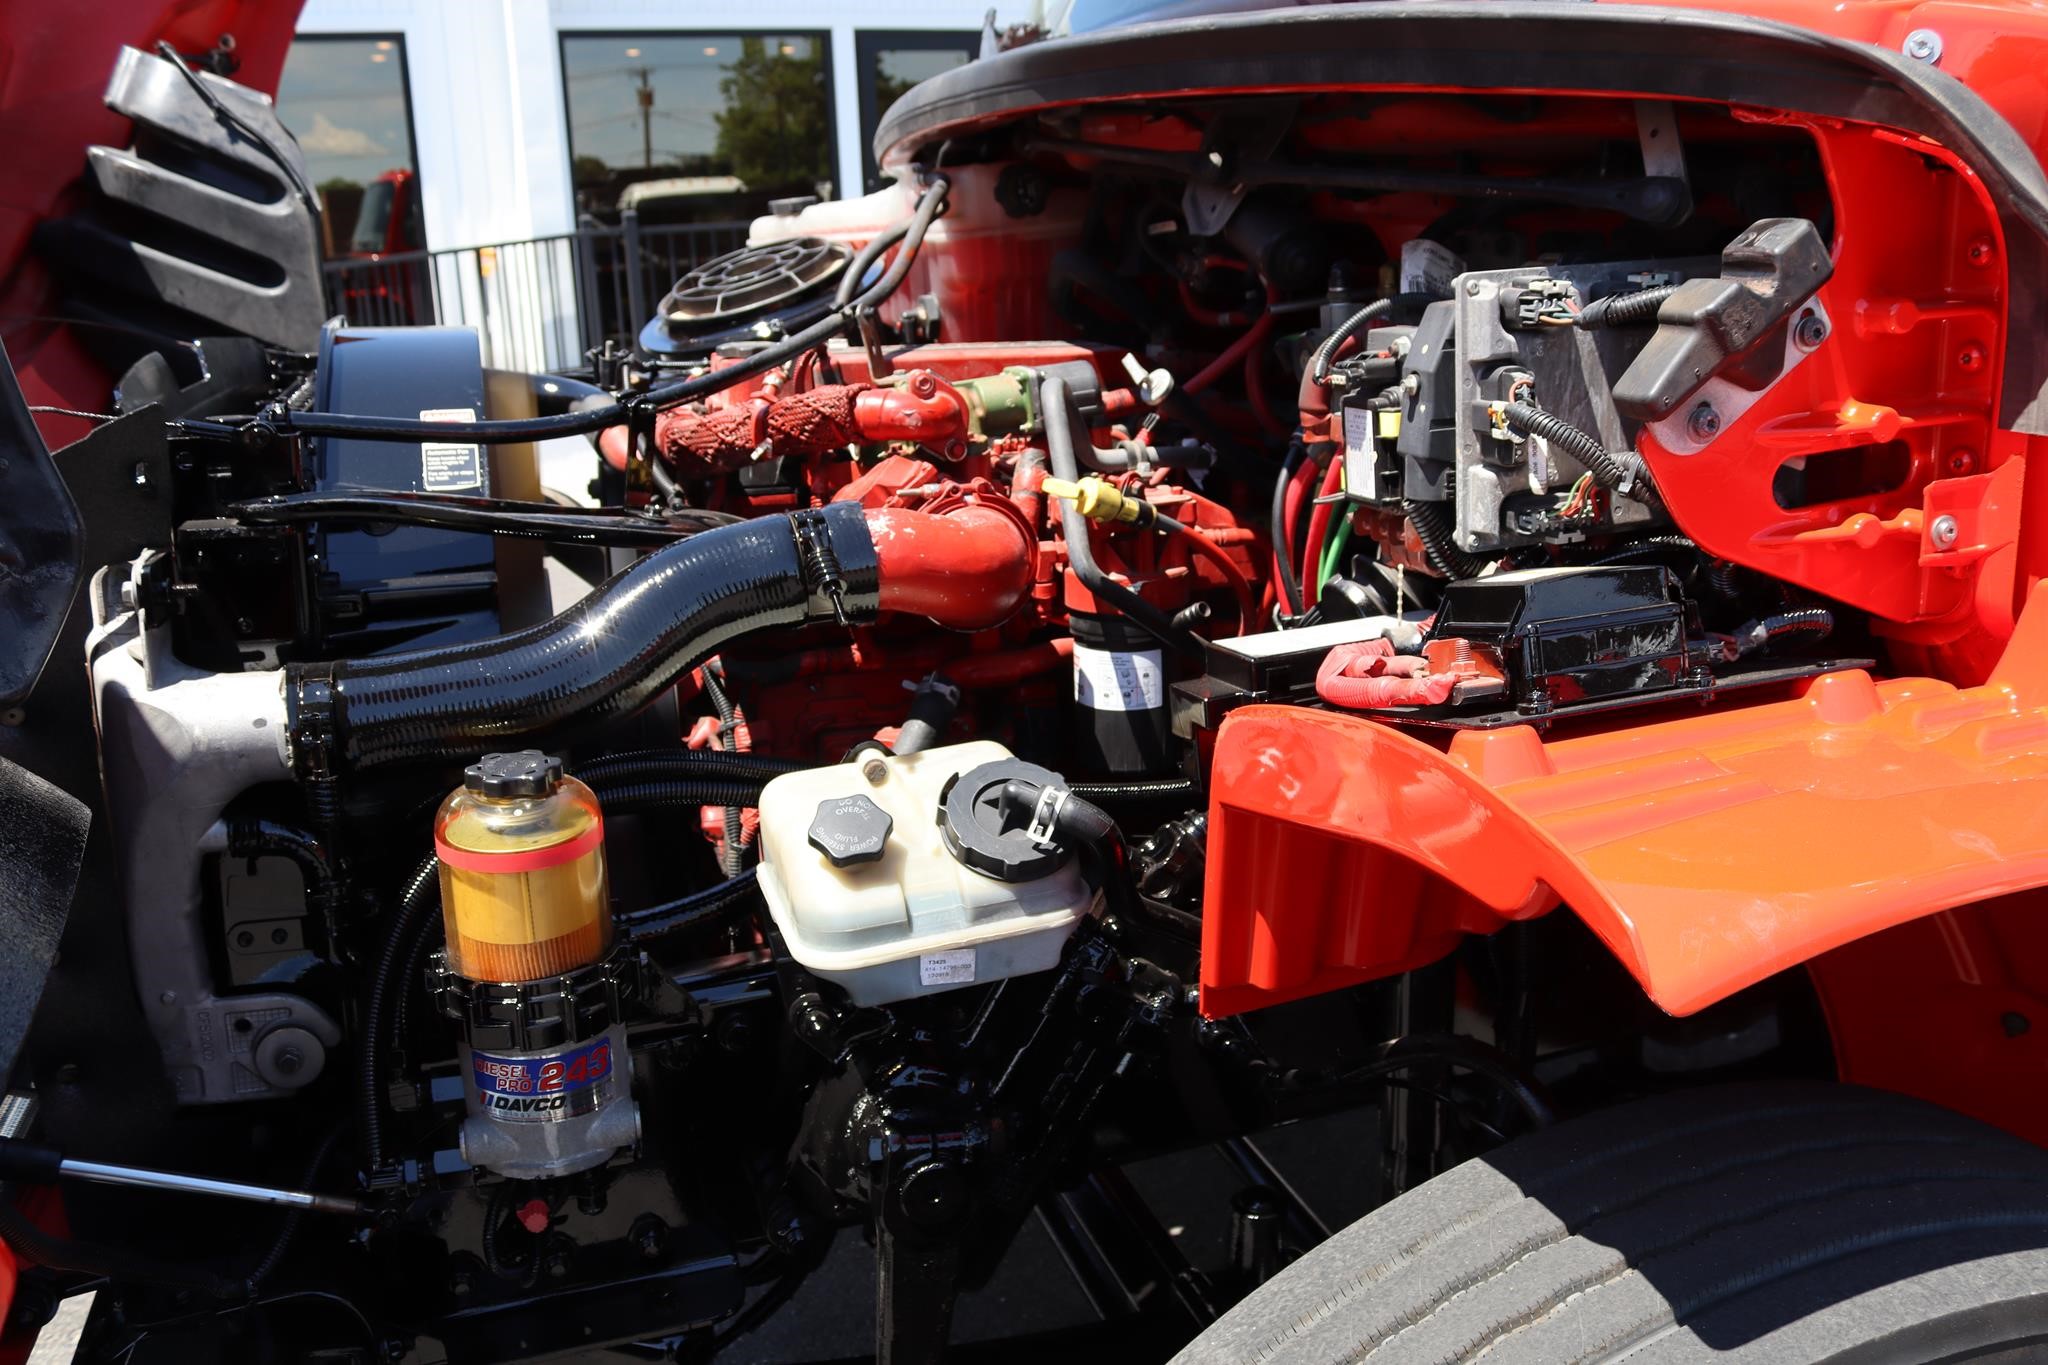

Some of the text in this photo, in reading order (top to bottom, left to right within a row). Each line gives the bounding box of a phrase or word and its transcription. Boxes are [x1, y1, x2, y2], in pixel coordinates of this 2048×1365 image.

[839, 798, 853, 806] DO
[849, 835, 879, 851] POWER
[475, 1058, 530, 1079] DIESEL
[537, 1043, 610, 1093] 243
[496, 1078, 533, 1093] PRO
[493, 1095, 566, 1112] DAVCO
